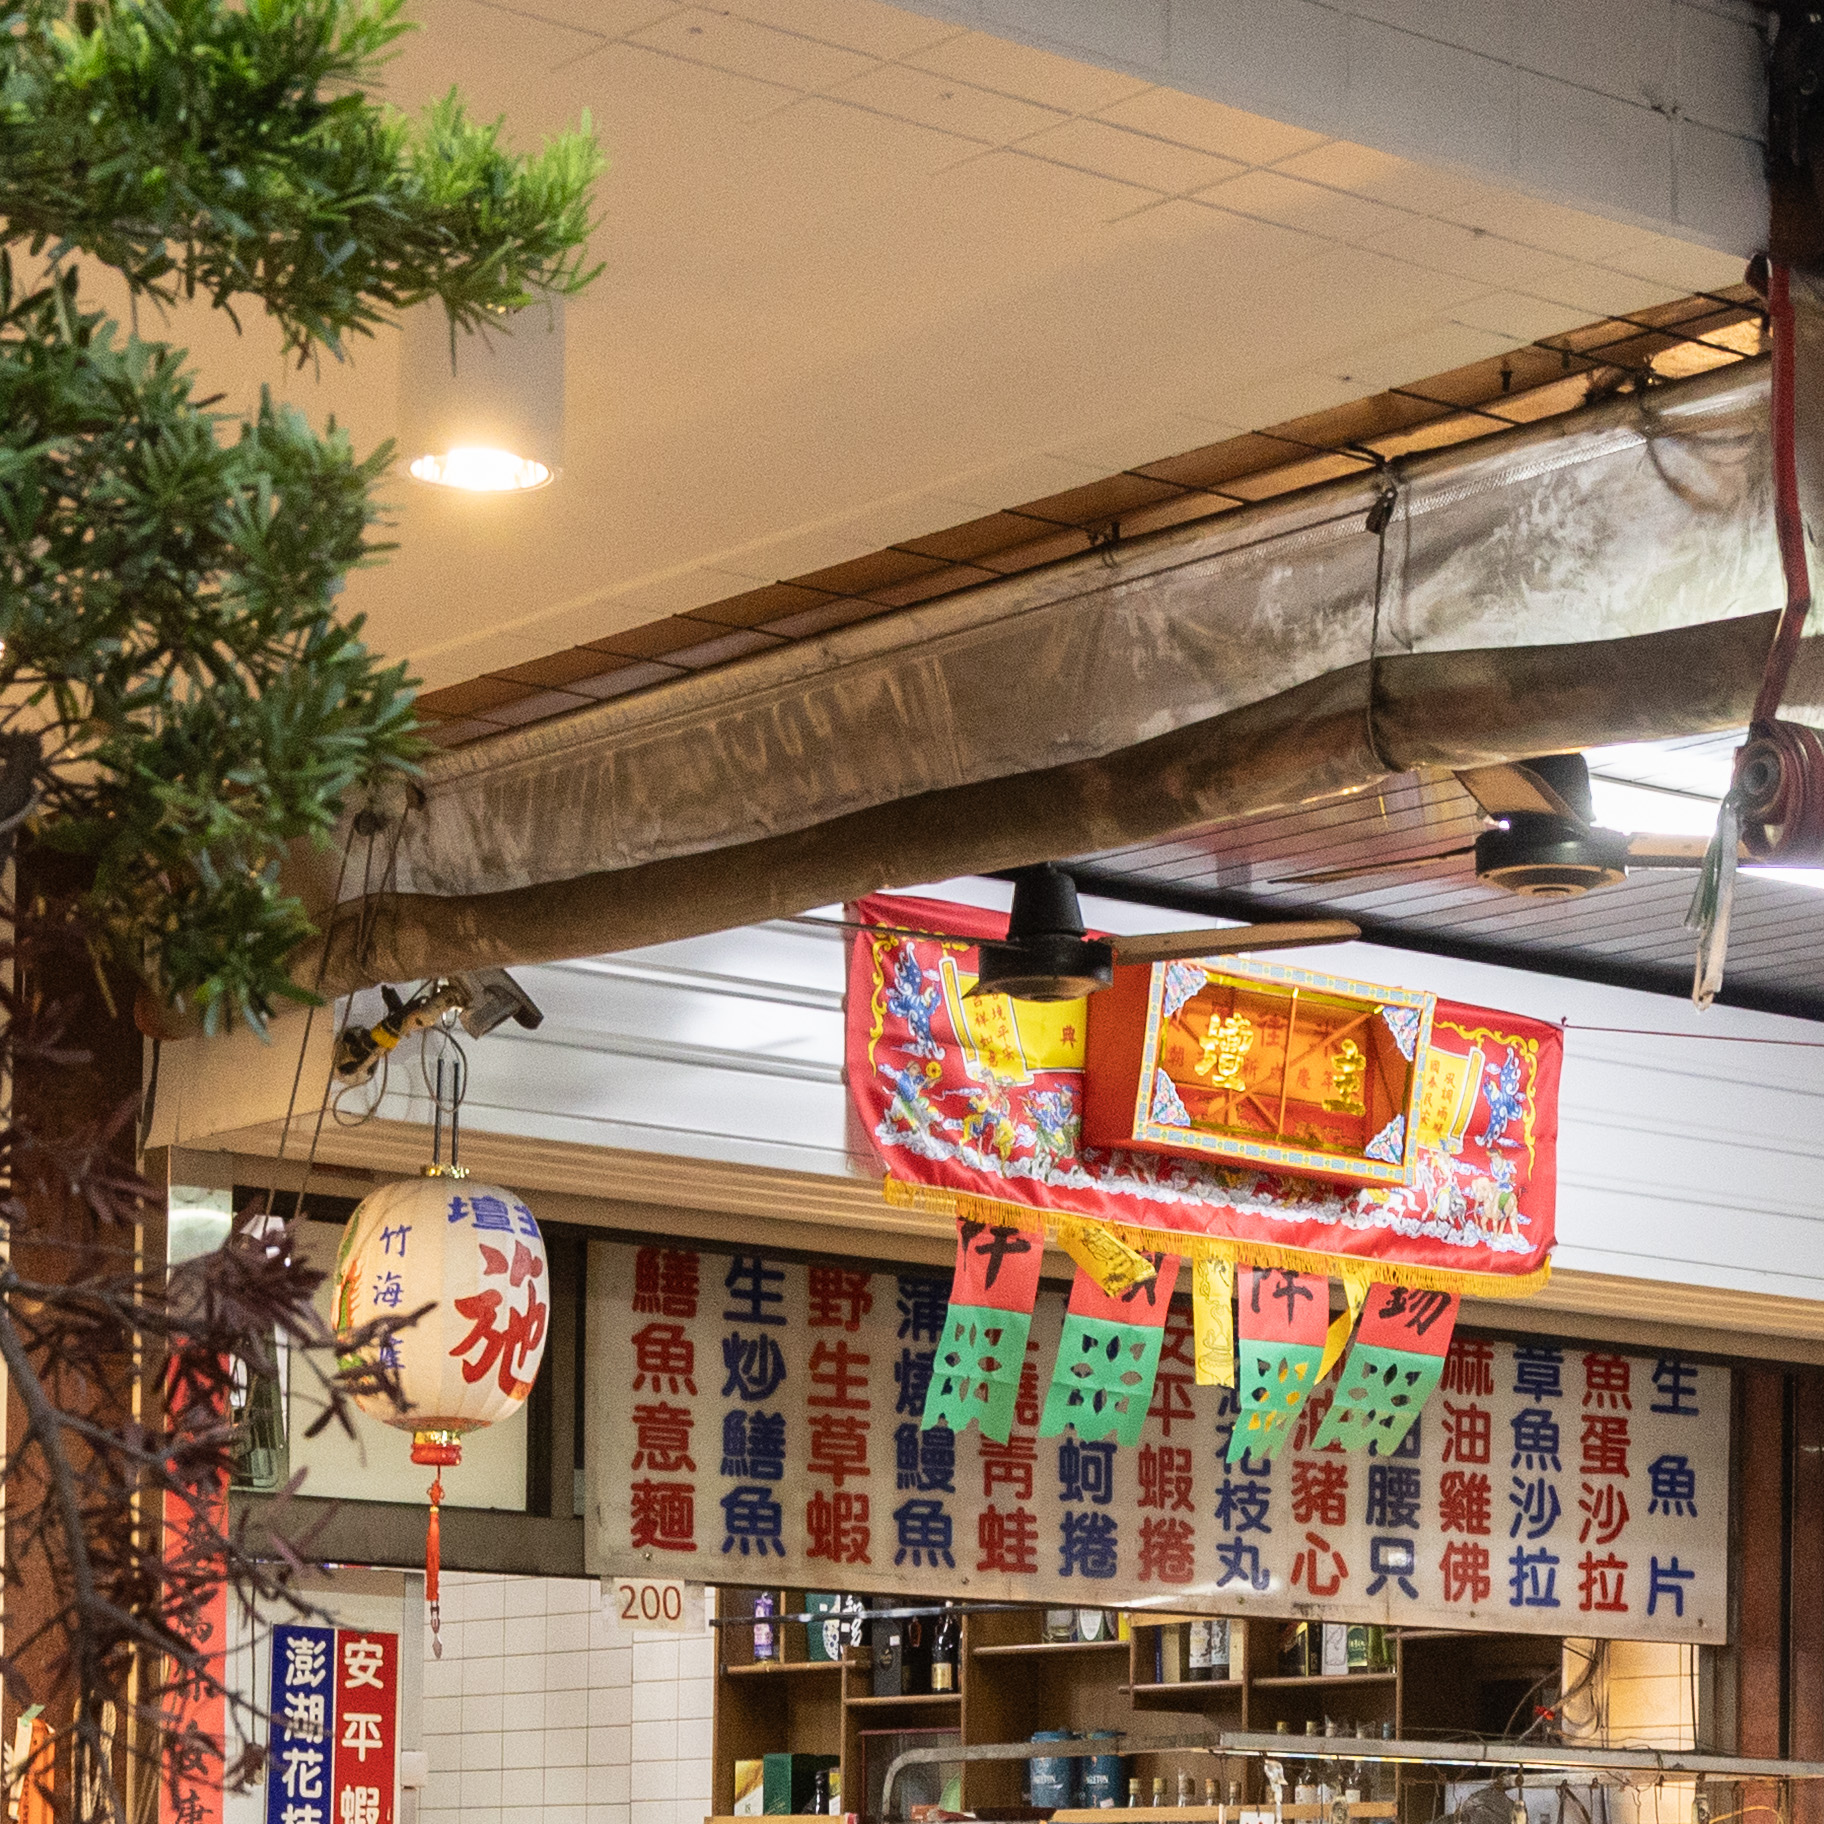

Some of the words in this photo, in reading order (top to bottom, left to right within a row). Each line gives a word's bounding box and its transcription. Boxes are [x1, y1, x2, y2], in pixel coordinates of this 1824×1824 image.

[989, 994, 1016, 1061] 境平安
[720, 1254, 788, 1558] 生炒鱔魚
[806, 1264, 873, 1566] 野生草蝦
[1290, 1387, 1349, 1597] 油豬心
[1509, 1344, 1563, 1609] 章魚沙拉
[1577, 1352, 1634, 1613] 魚蛋沙拉
[1648, 1357, 1701, 1619] 生魚片
[619, 1584, 682, 1621] 200
